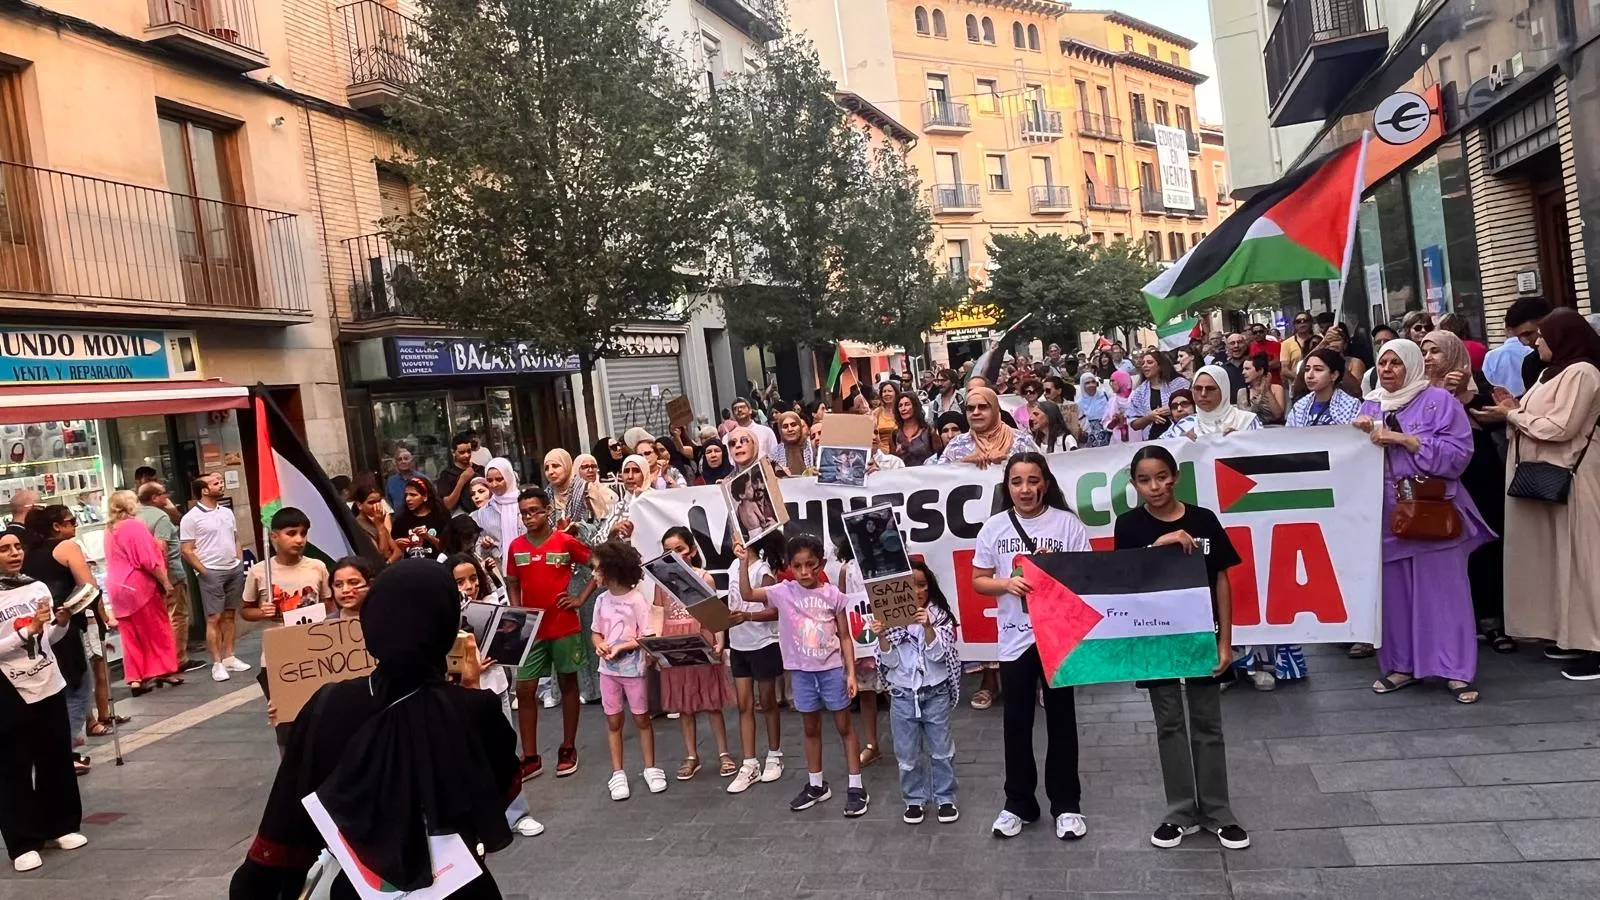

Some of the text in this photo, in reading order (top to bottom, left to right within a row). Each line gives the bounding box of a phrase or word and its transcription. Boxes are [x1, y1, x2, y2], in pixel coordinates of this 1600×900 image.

[1170, 149, 1179, 165] EN
[1162, 165, 1188, 190] VENTA
[84, 334, 153, 357] MOVIL
[13, 365, 49, 381] VENTA
[56, 366, 63, 380] Y
[872, 580, 913, 596] GAZA
[874, 592, 915, 609] EN UNA
[883, 604, 918, 621] FOTO
[1106, 608, 1129, 618] Free
[307, 618, 364, 652] STO
[279, 648, 378, 683] GENOCI
